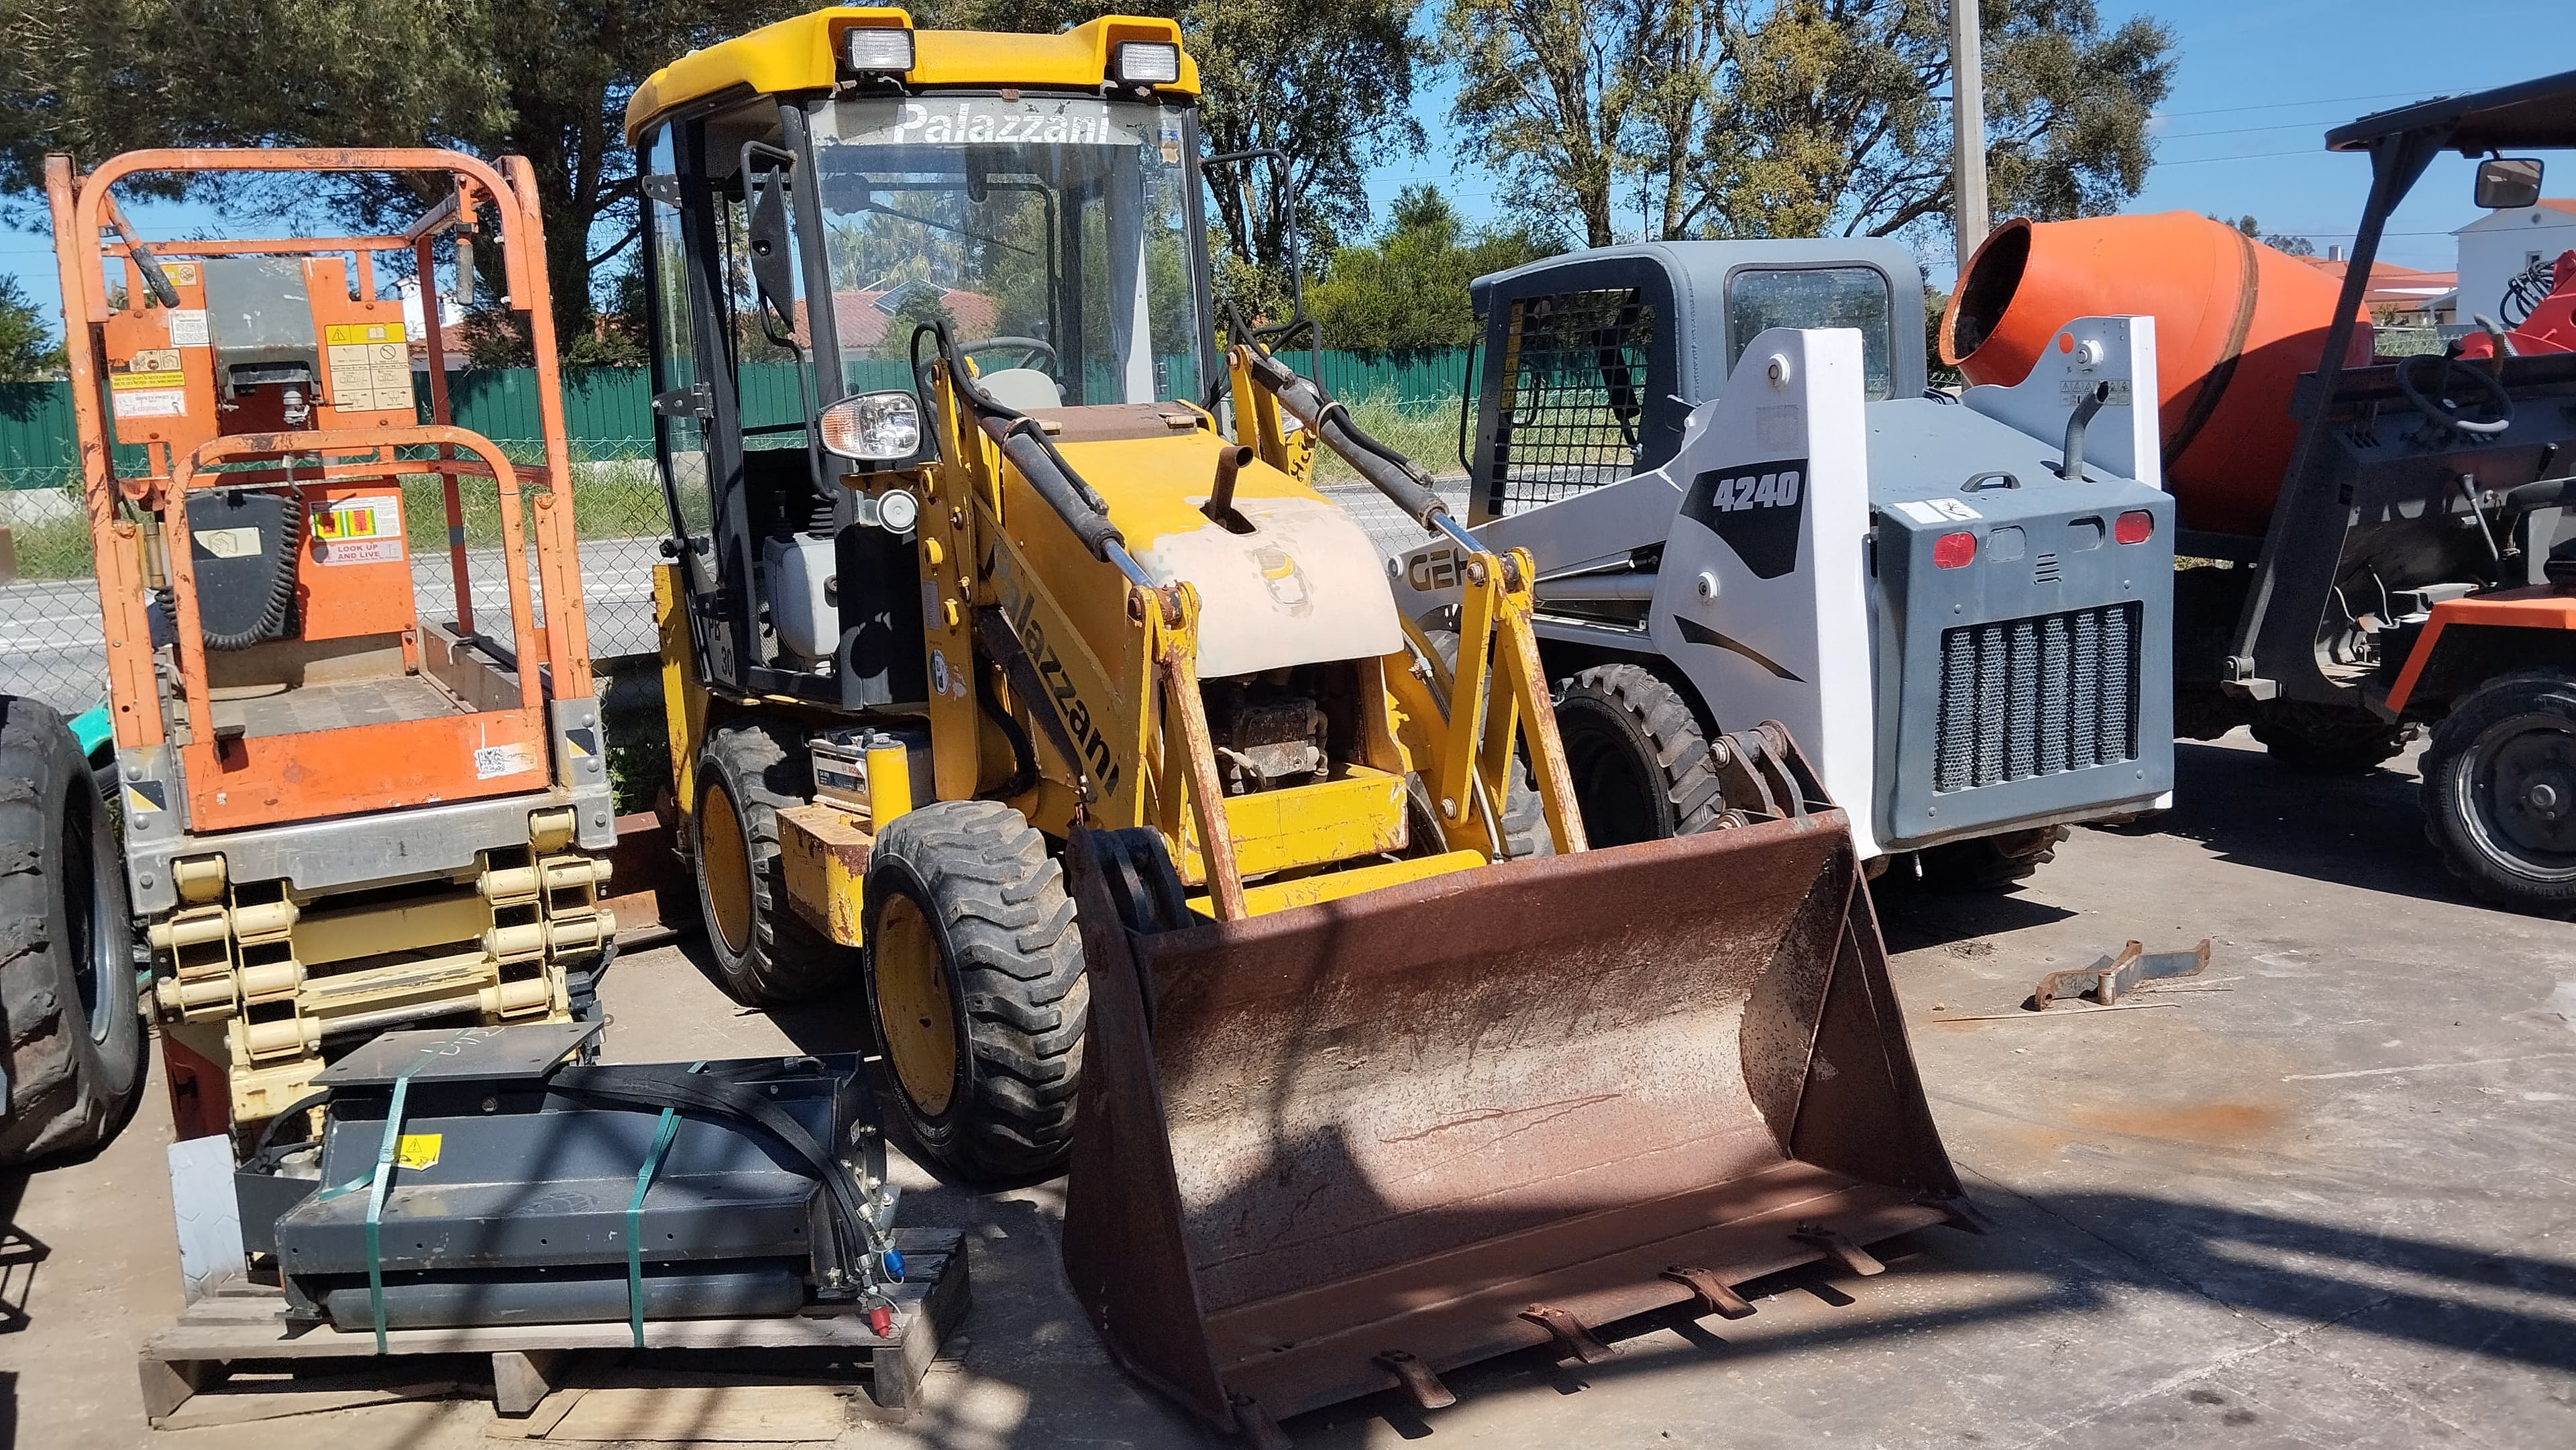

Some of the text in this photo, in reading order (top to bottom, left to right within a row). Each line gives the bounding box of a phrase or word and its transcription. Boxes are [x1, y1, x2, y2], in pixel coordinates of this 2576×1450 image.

[893, 103, 1111, 144] Palazzani
[1713, 470, 1800, 513] 4240
[1409, 548, 1468, 592] GEH
[708, 617, 721, 641] PB
[721, 645, 733, 678] 30
